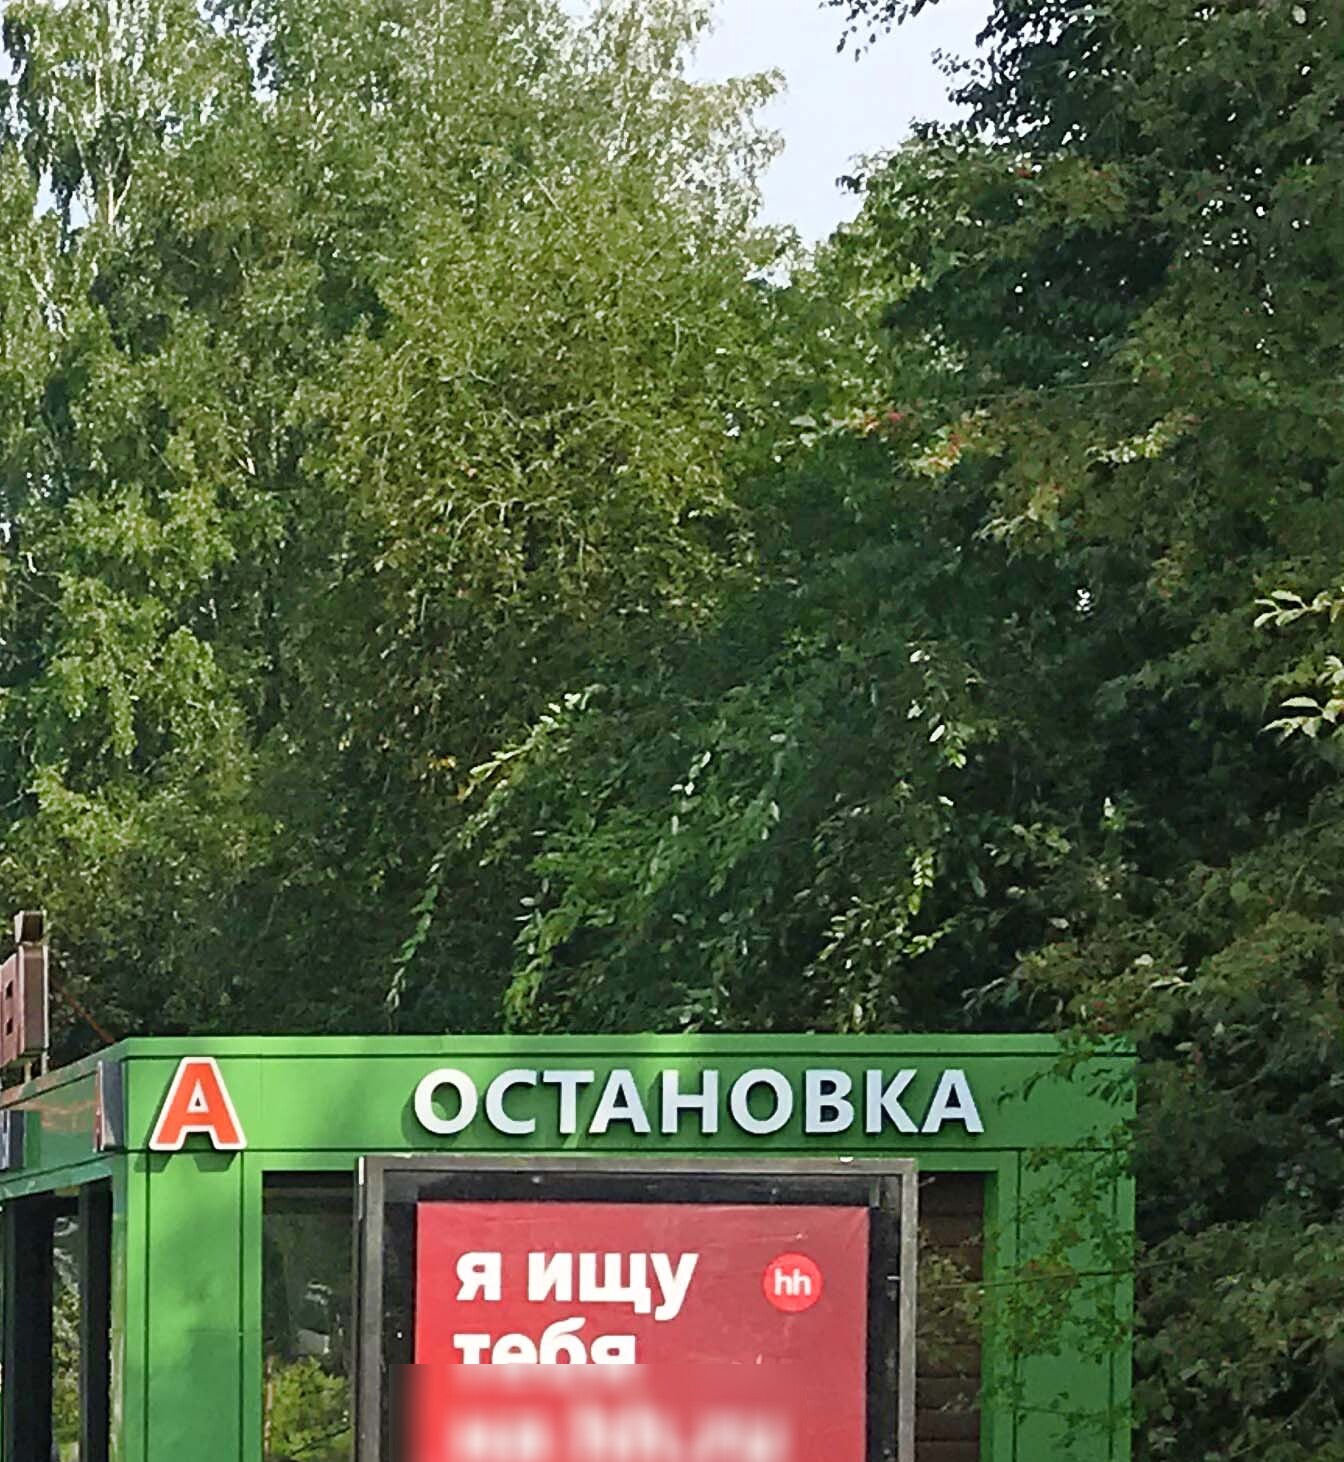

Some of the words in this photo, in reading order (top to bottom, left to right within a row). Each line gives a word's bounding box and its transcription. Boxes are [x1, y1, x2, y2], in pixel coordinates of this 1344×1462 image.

[149, 1057, 247, 1150] А
[413, 1068, 983, 1136] ОСТАНОВКА
[455, 1252, 502, 1301] я
[527, 1252, 699, 1321] ищу
[773, 1270, 812, 1296] hh
